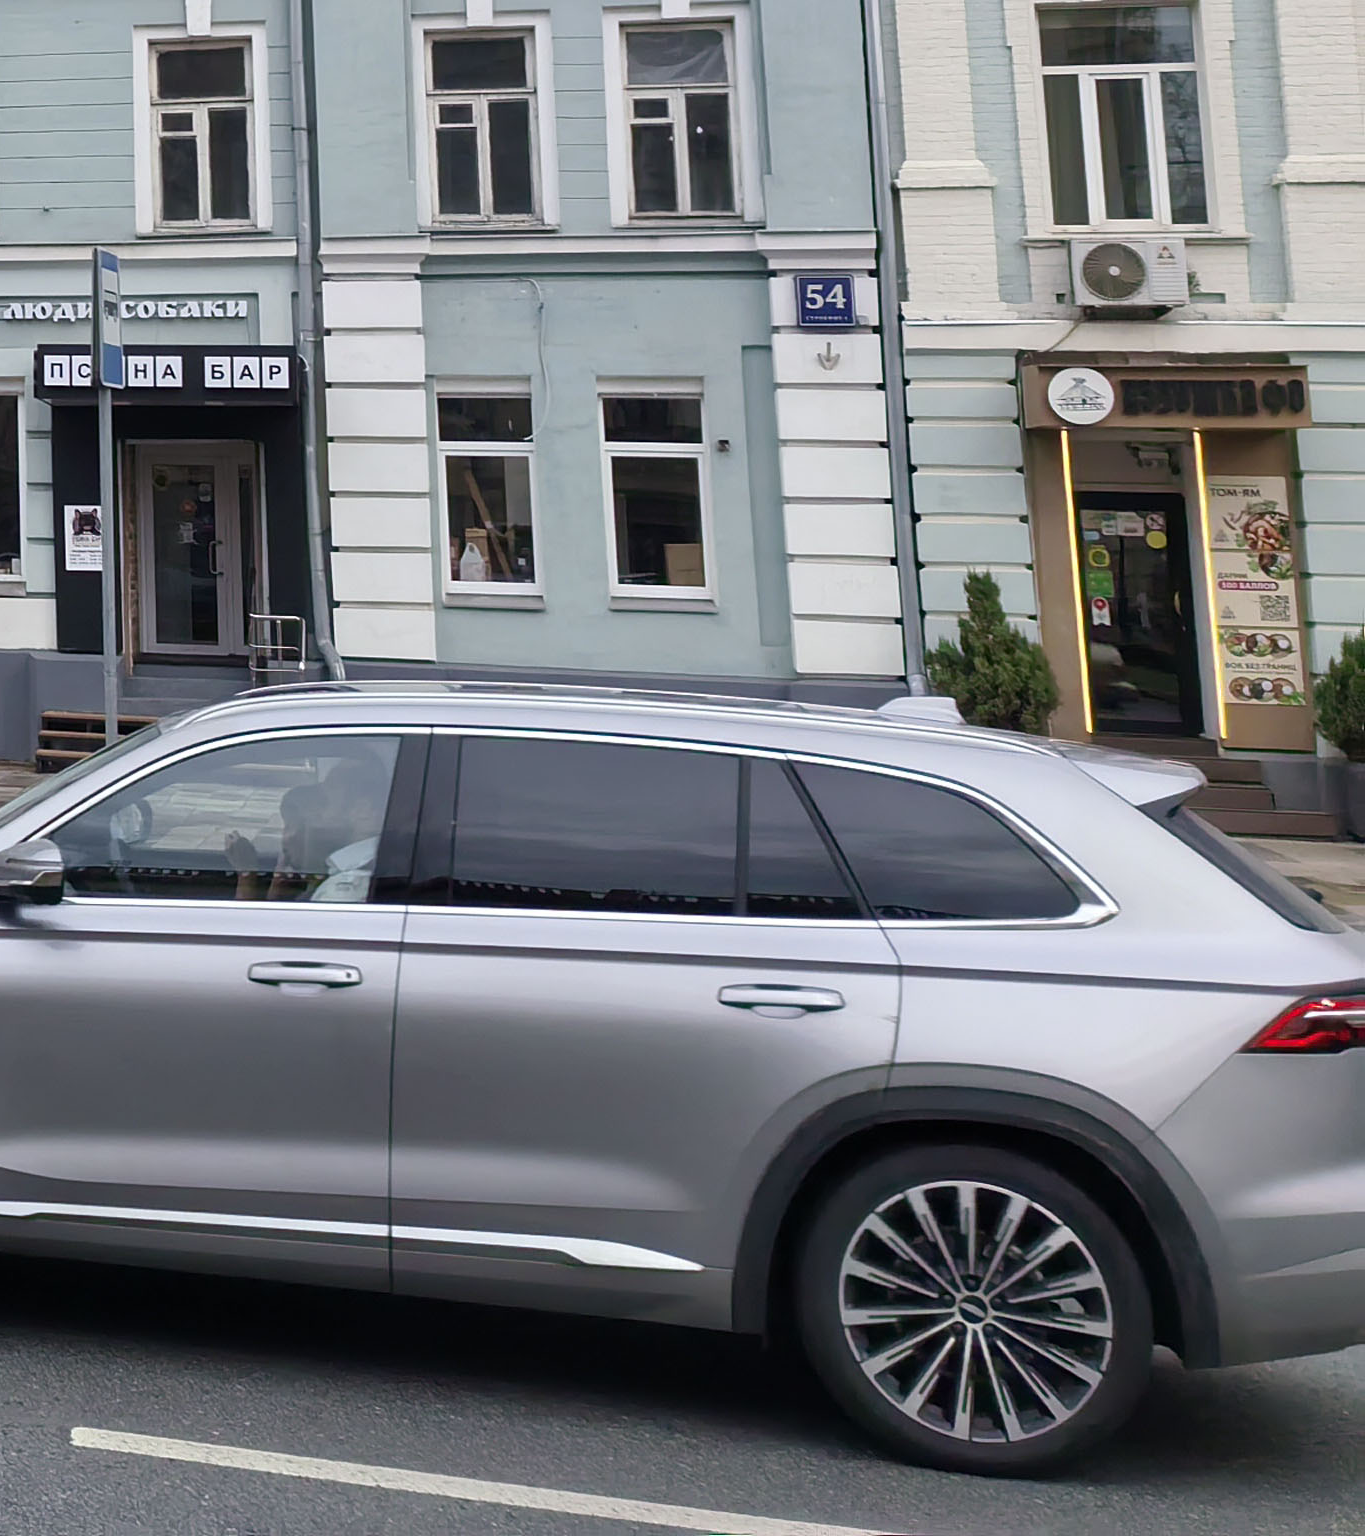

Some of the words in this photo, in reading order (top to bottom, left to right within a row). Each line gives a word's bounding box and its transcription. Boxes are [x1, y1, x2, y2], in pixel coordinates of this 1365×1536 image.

[805, 283, 847, 310] 54
[120, 300, 248, 319] СОБАКИ
[50, 362, 177, 381] ПСНА
[210, 363, 282, 381] БАР
